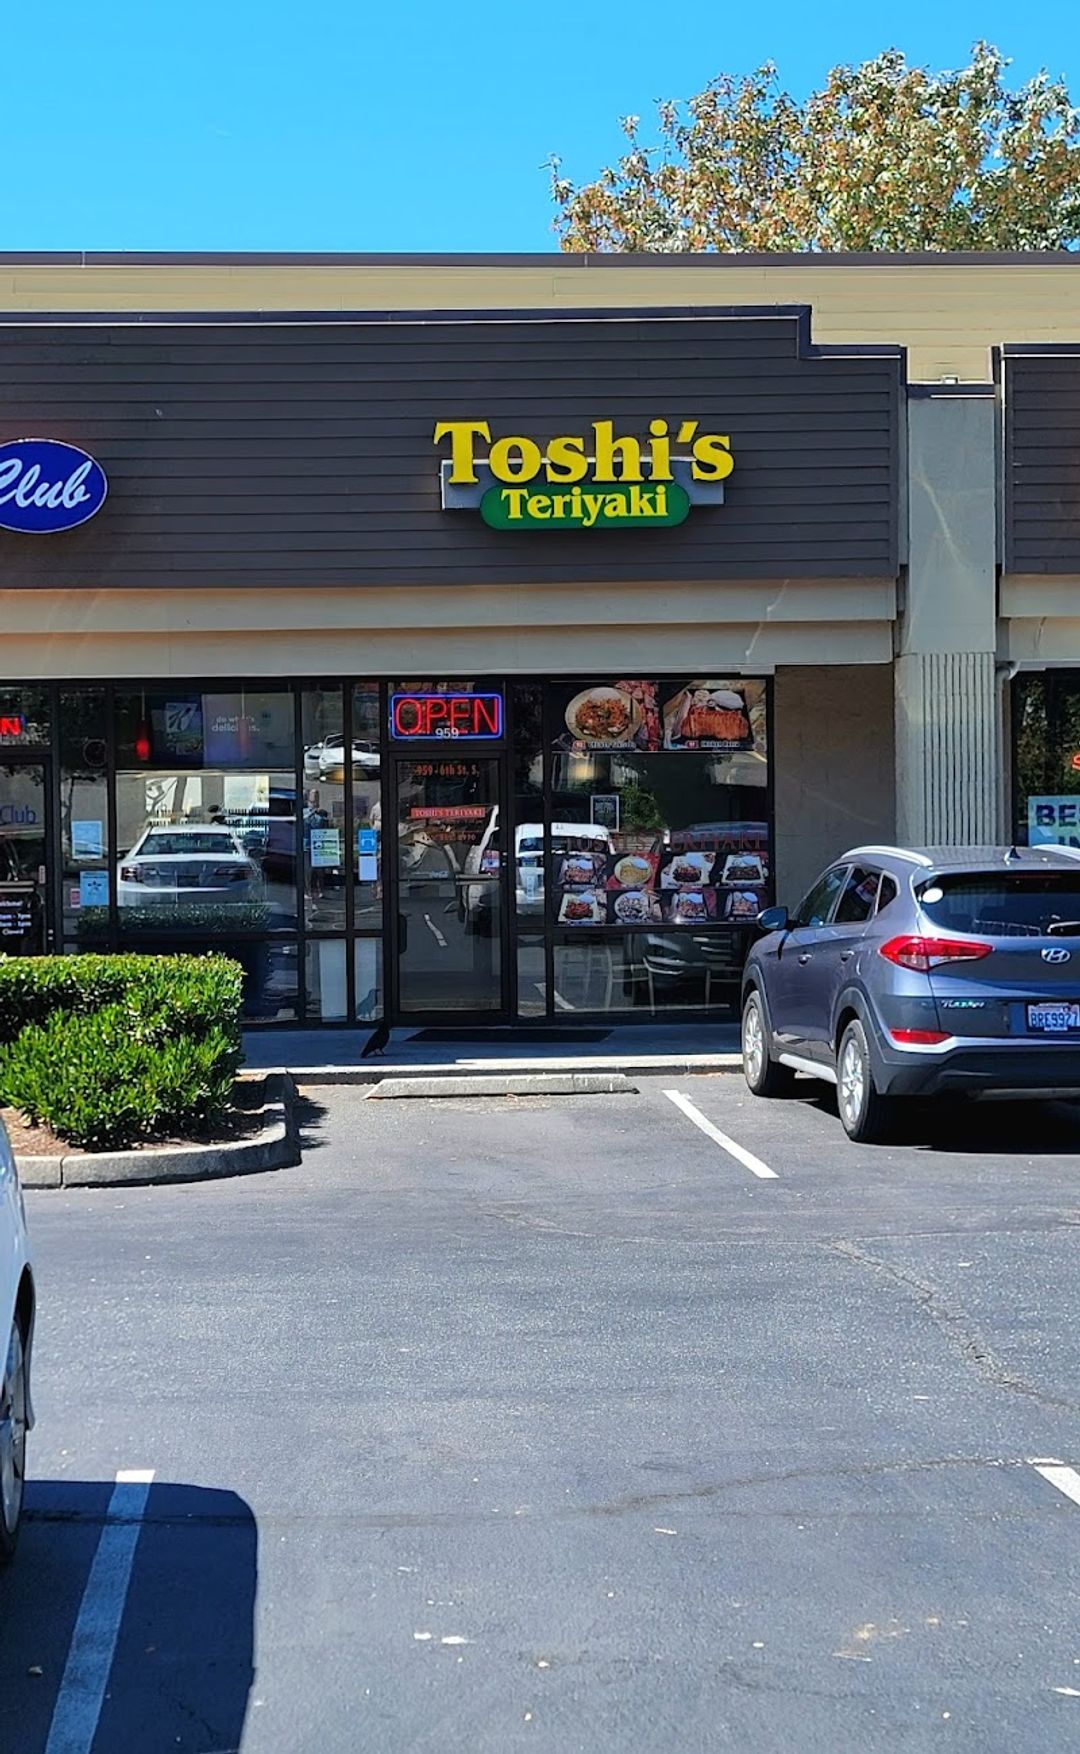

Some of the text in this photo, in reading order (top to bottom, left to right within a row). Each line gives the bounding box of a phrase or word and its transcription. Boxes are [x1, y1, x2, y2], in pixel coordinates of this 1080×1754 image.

[433, 419, 734, 483] Toshi's
[0, 458, 92, 508] Club
[501, 485, 668, 526] Teriyaki
[395, 698, 498, 735] OPEN
[435, 727, 459, 739] 959
[439, 764, 455, 776] 6th
[0, 804, 36, 824] Club
[1036, 804, 1080, 827] BE
